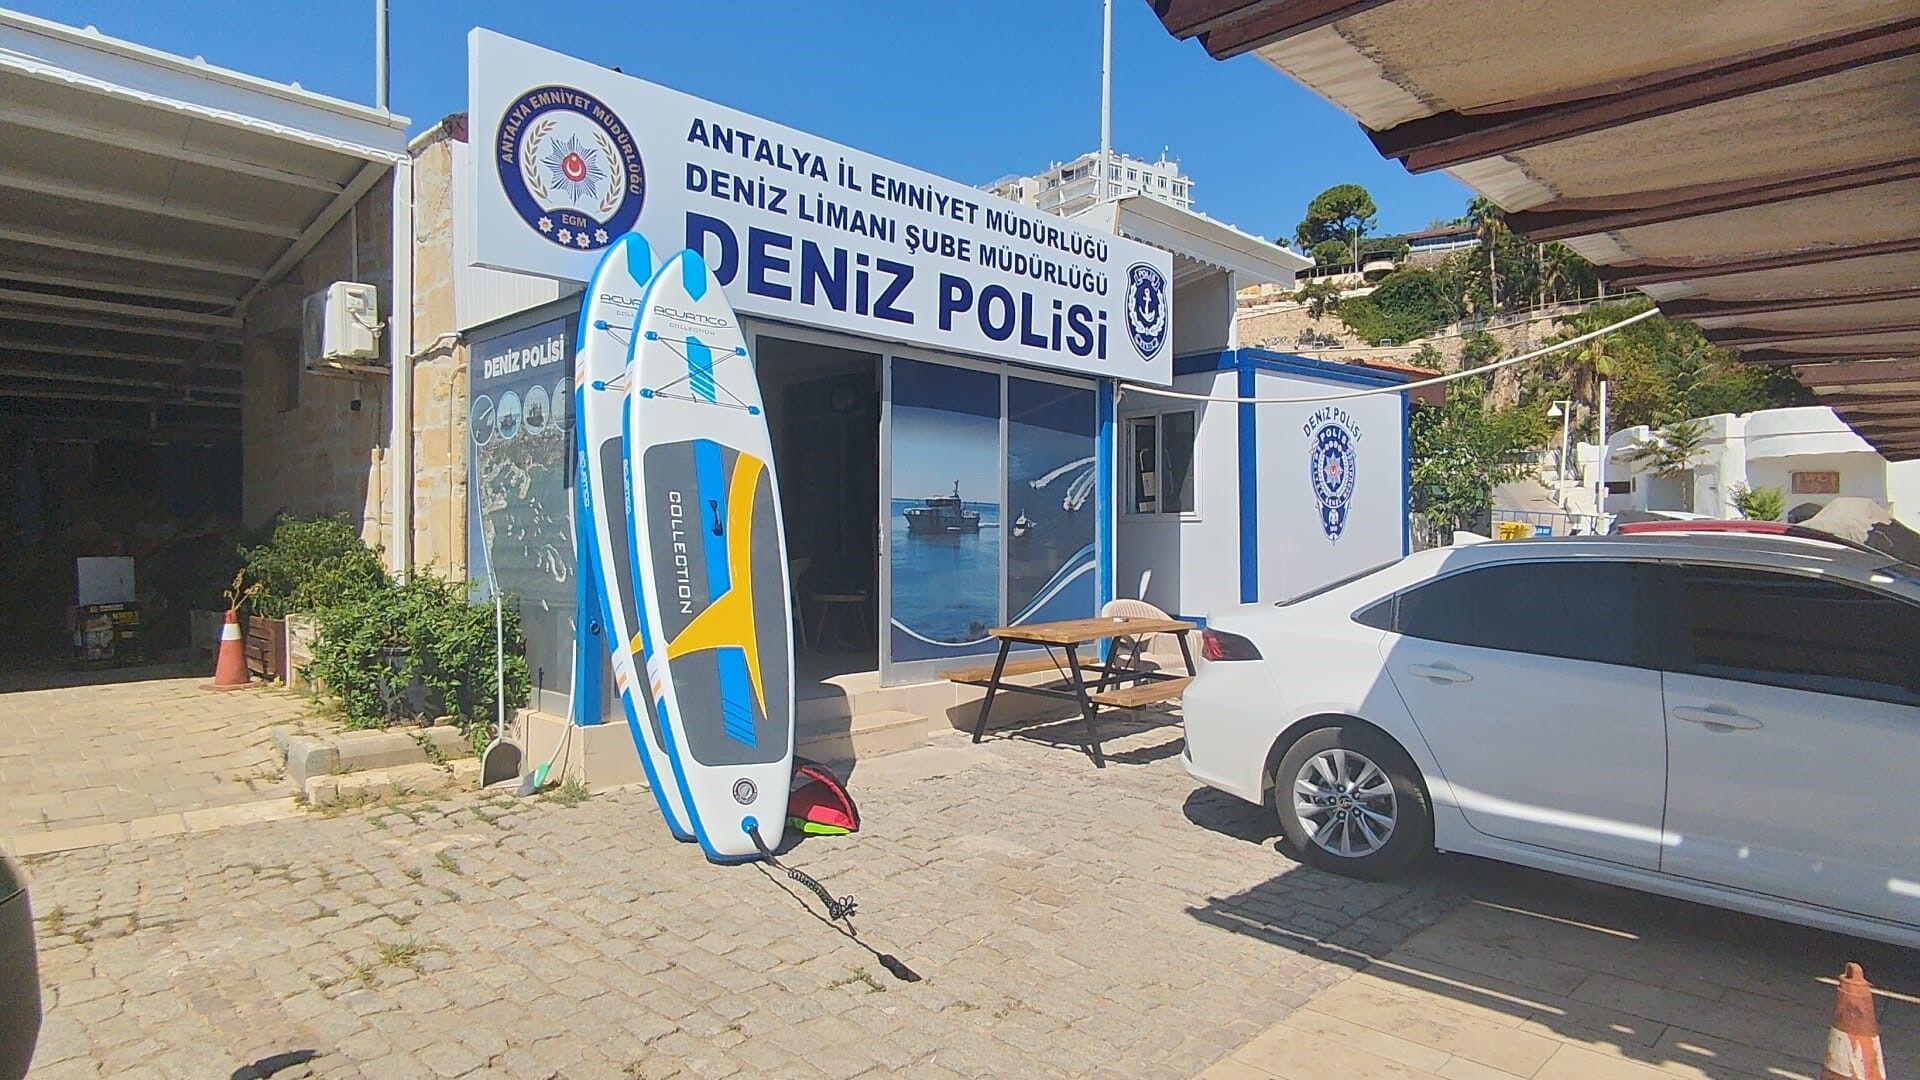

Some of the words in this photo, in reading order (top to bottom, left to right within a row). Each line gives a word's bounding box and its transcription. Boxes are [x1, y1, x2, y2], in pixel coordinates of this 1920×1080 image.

[501, 104, 532, 165] ANTALYA
[529, 88, 592, 109] EMNİYET
[592, 104, 642, 196] MÜDÜRLÜĞÜ
[686, 117, 828, 182] ANTALYA
[837, 156, 862, 192] İL
[871, 174, 980, 225] EMNİYET
[986, 207, 1109, 263] MÜDÜRLÜĞÜ
[561, 213, 588, 229] EGM
[686, 162, 788, 215] DENİZ
[799, 192, 896, 242] LİMANI
[905, 224, 971, 262] ŞUBE
[979, 243, 1108, 297] MÜDÜRLÜĞÜ
[484, 348, 520, 380] DENİZ
[522, 333, 565, 370] POLİSİ
[653, 305, 729, 328] ACUATICO
[669, 491, 693, 614] COLLECTION
